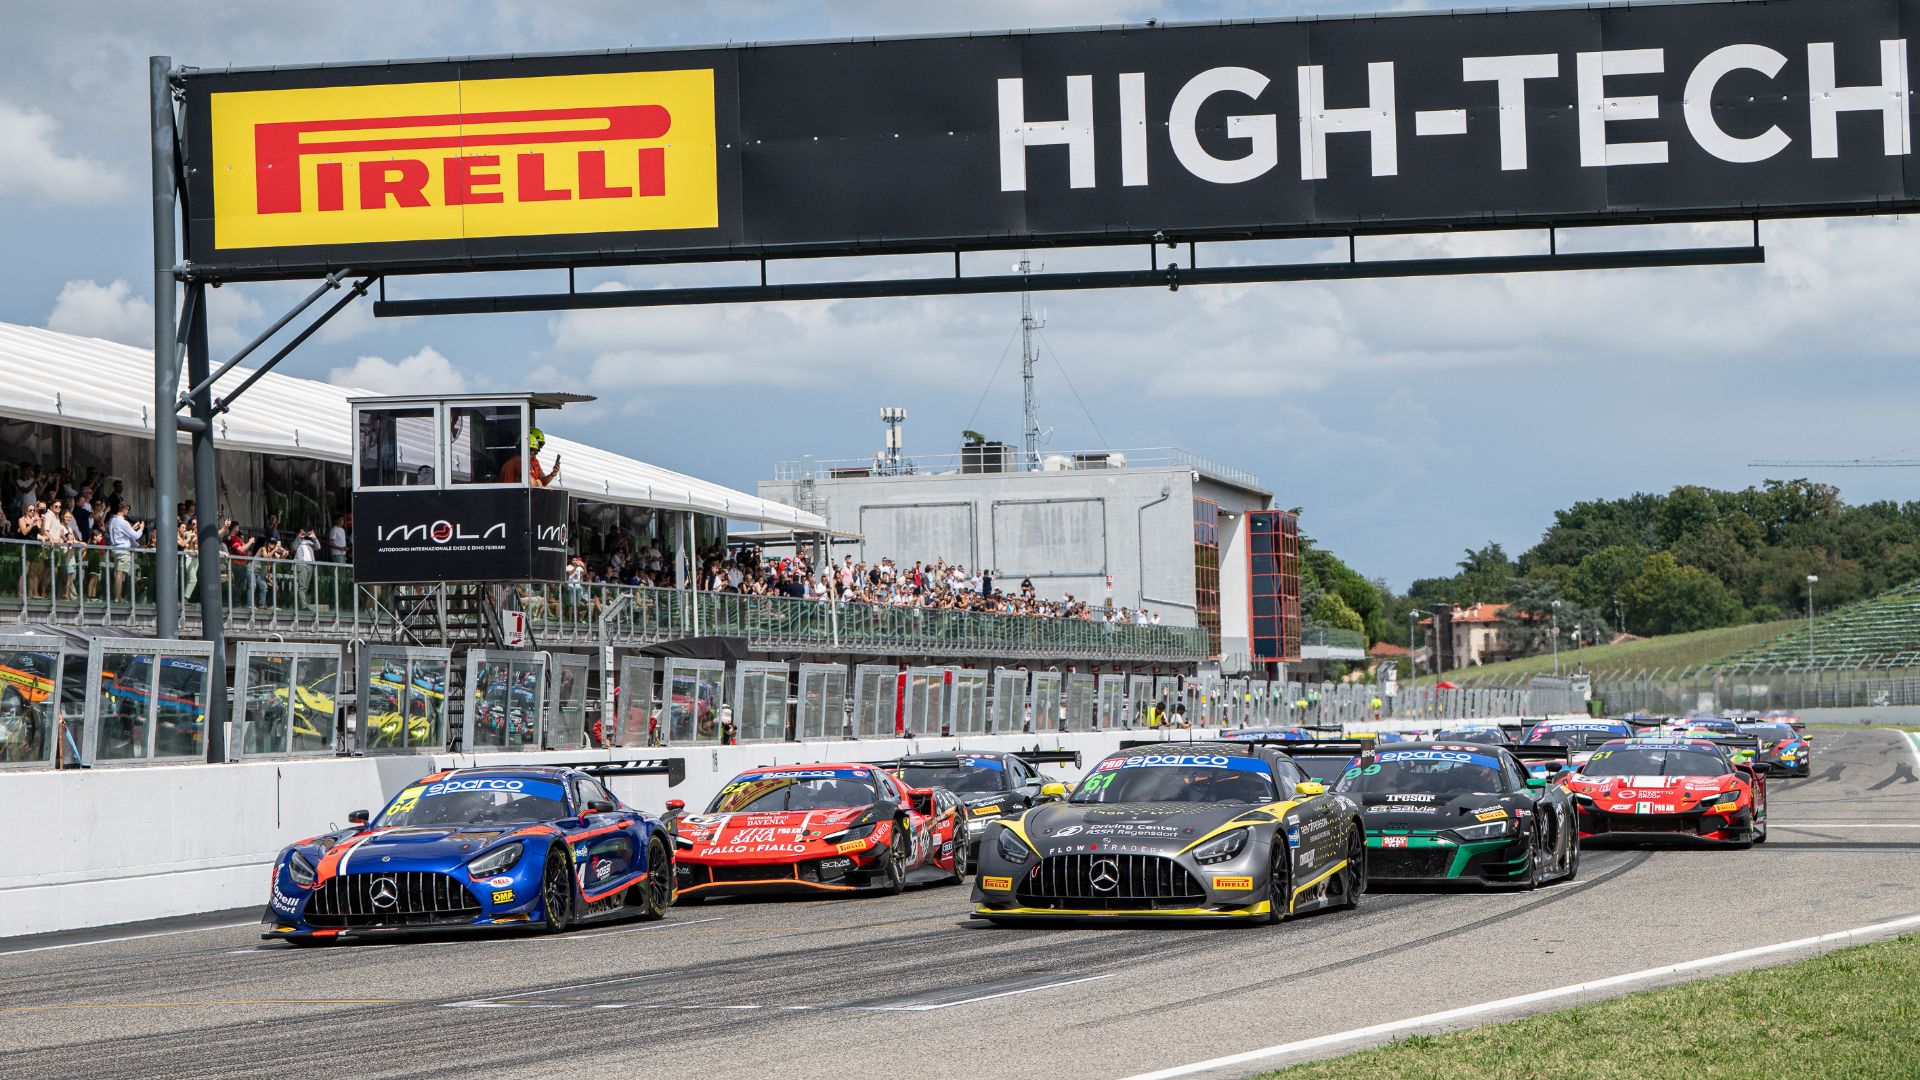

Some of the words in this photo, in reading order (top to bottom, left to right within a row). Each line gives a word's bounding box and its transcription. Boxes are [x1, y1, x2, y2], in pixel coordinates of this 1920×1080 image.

[997, 39, 1911, 191] HIGH-TECH
[254, 104, 671, 214] PIRELLI
[377, 519, 506, 543] IMOLA
[509, 631, 522, 639] FIRE
[1552, 724, 1610, 732] sparco
[1530, 733, 1543, 743] 2
[1380, 751, 1472, 763] sparco
[1591, 751, 1613, 761] 51
[1100, 759, 1123, 770] PRO
[1124, 755, 1230, 769] sparco
[762, 770, 836, 779] sparco
[1345, 763, 1382, 779] 99
[1084, 772, 1118, 792] 61
[427, 780, 524, 797] sparco
[386, 796, 417, 816] 64
[1090, 823, 1131, 832] Driving
[1132, 824, 1179, 833] Center
[1117, 829, 1179, 839] Regensdorf
[700, 845, 747, 857] FIALLO
[756, 843, 806, 853] FIALLO
[1049, 845, 1085, 855] FLOW
[1103, 844, 1165, 854] TRADERS
[273, 863, 300, 906] Antonelli
[984, 878, 1009, 888] PIRELLI
[1216, 878, 1250, 888] PIRELLI
[492, 892, 513, 902] OMP
[272, 897, 296, 914] Sport
